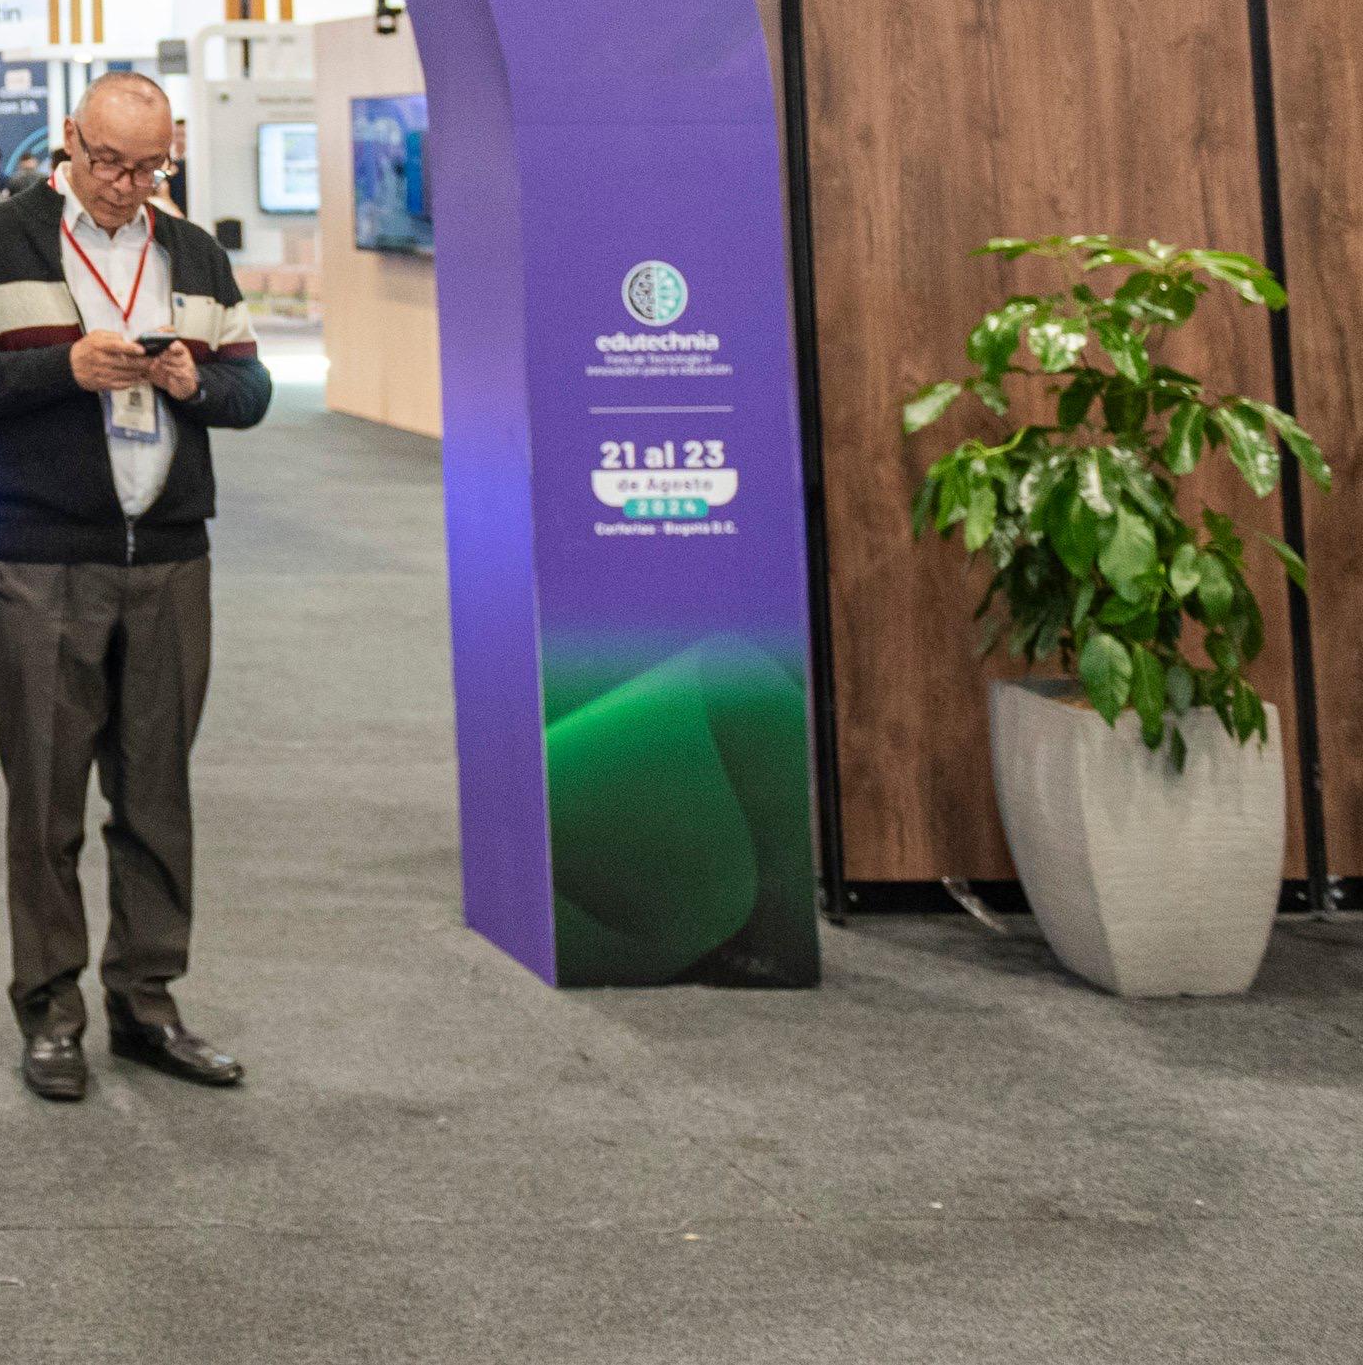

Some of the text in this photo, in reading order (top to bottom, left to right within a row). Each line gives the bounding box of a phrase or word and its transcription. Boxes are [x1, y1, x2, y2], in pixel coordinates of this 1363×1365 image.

[595, 330, 720, 352] edutechnia
[600, 440, 726, 469] 21 al 23
[617, 477, 714, 494] de Agosto
[637, 501, 697, 516] 2024
